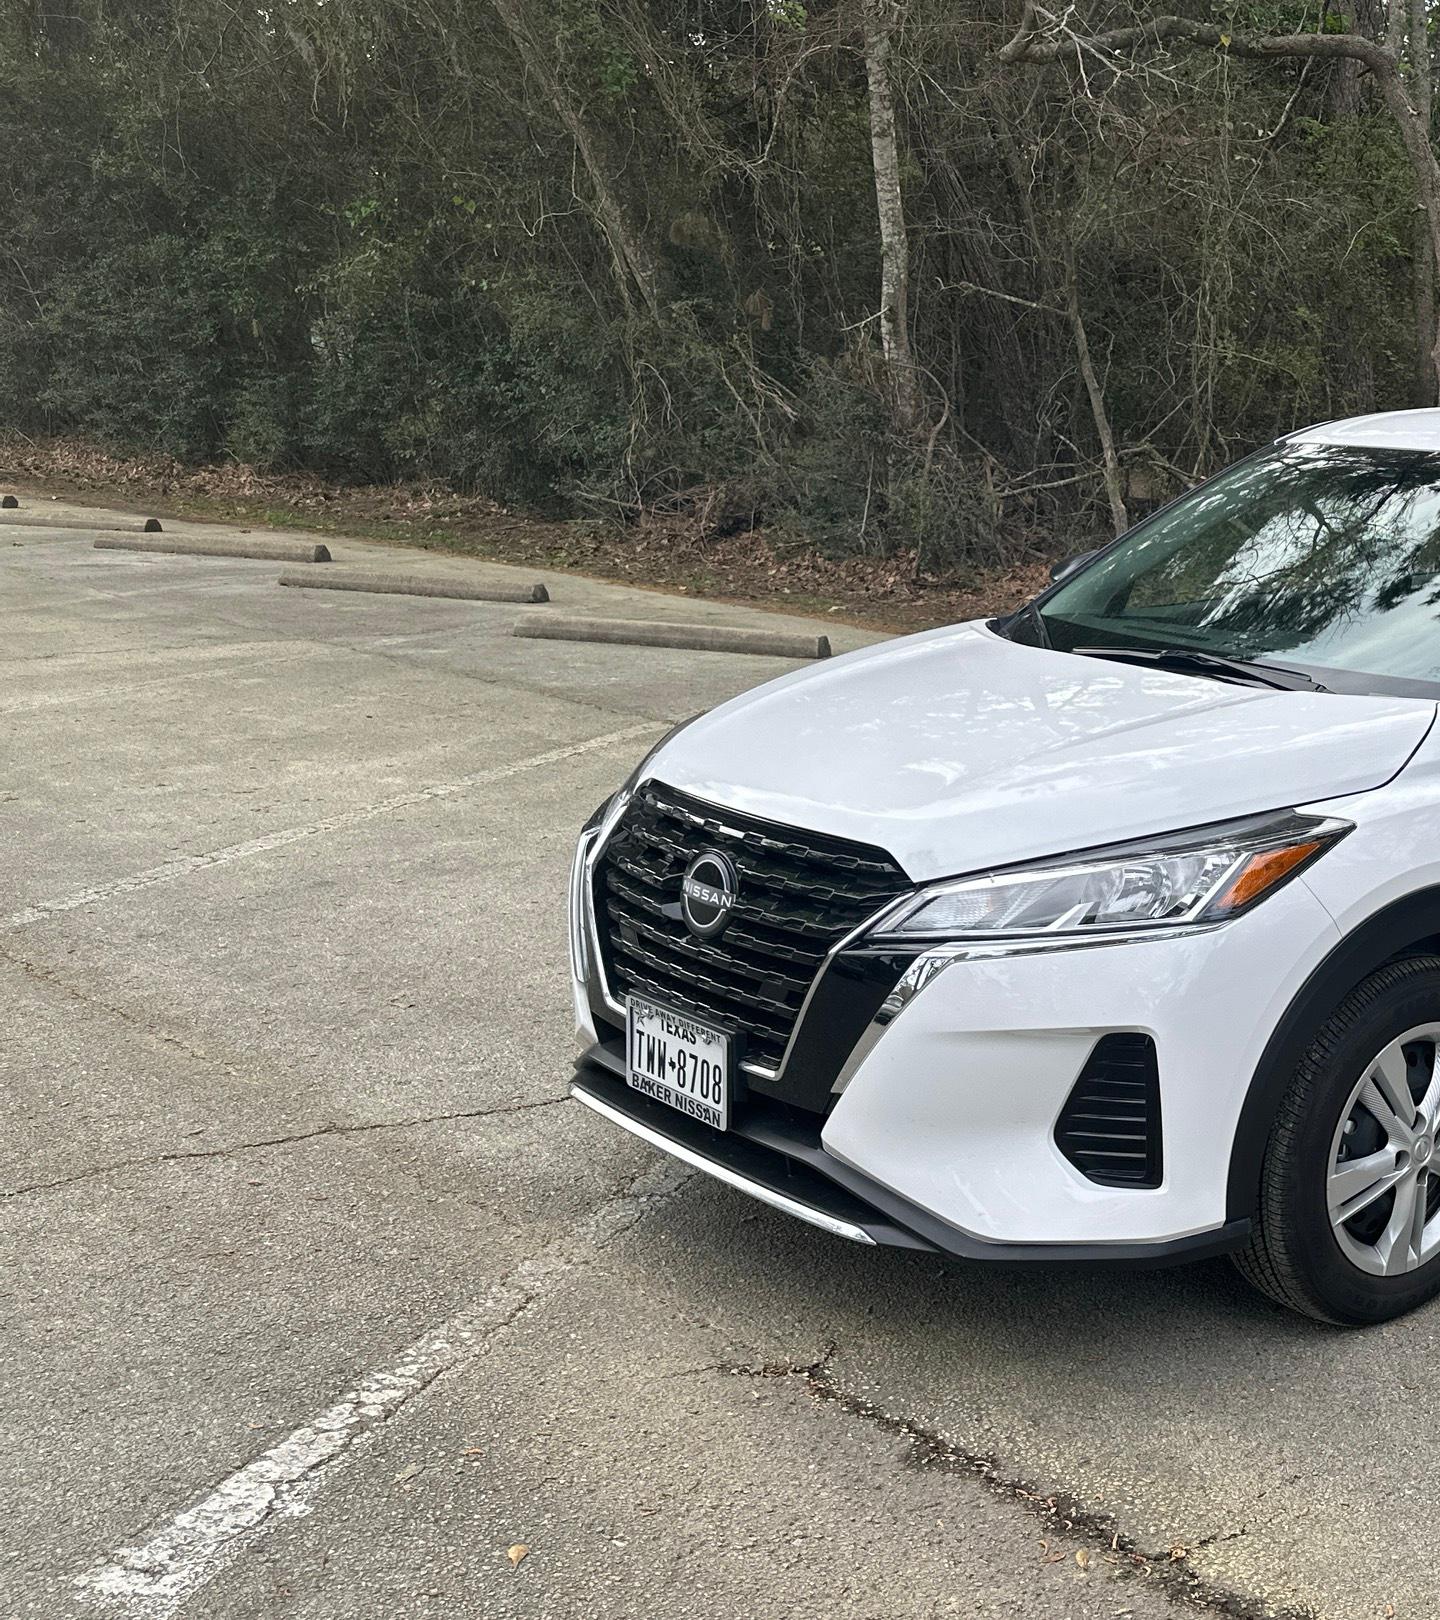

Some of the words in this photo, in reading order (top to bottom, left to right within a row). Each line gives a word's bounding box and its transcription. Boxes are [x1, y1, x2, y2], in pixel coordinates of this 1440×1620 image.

[682, 880, 732, 908] NISSAN
[630, 997, 654, 1014] DRIVE
[655, 1008, 676, 1025] AWAY
[679, 1018, 721, 1043] DIFFERENT
[660, 1018, 697, 1046] TEXAS
[632, 1073, 672, 1104] BAKER
[675, 1093, 721, 1128] NISSAN
